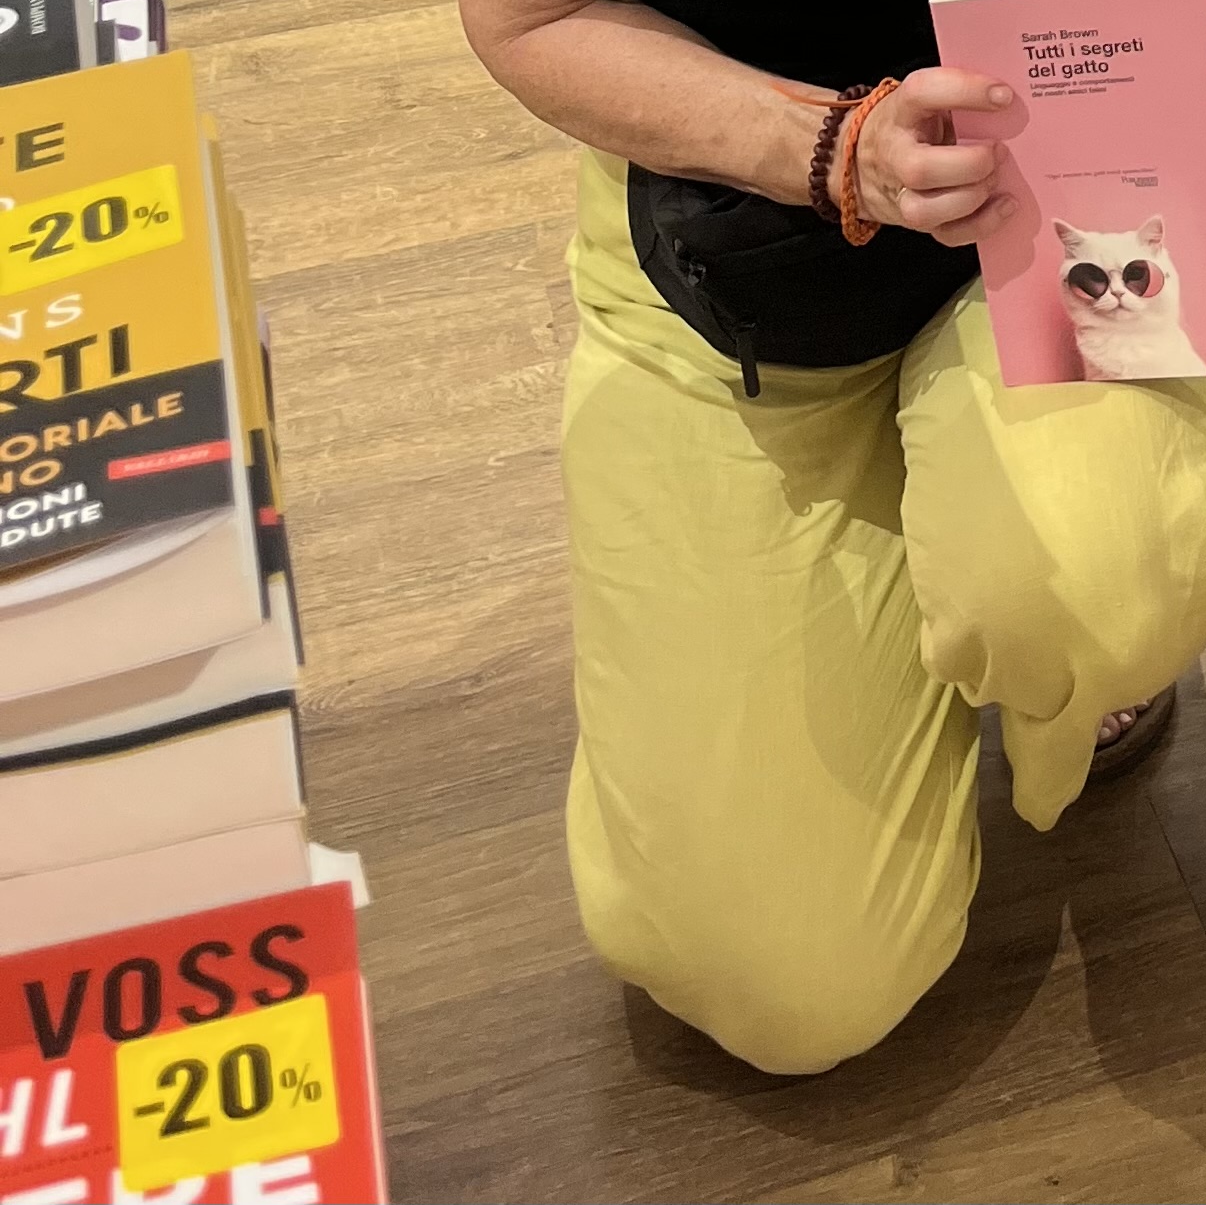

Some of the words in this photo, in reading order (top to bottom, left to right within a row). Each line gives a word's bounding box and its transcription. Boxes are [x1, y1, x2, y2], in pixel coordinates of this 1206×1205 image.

[1022, 30, 1057, 43] Sarah
[1060, 28, 1099, 41] Brown
[1023, 43, 1065, 61] Tutti
[1071, 43, 1076, 57] i
[1081, 38, 1144, 58] segreti
[1028, 62, 1056, 78] del
[1062, 60, 1109, 81] gatto
[0, 122, 64, 172] E
[9, 196, 170, 263] -20%
[23, 923, 310, 1062] VOSS
[133, 1043, 322, 1140] -20%
